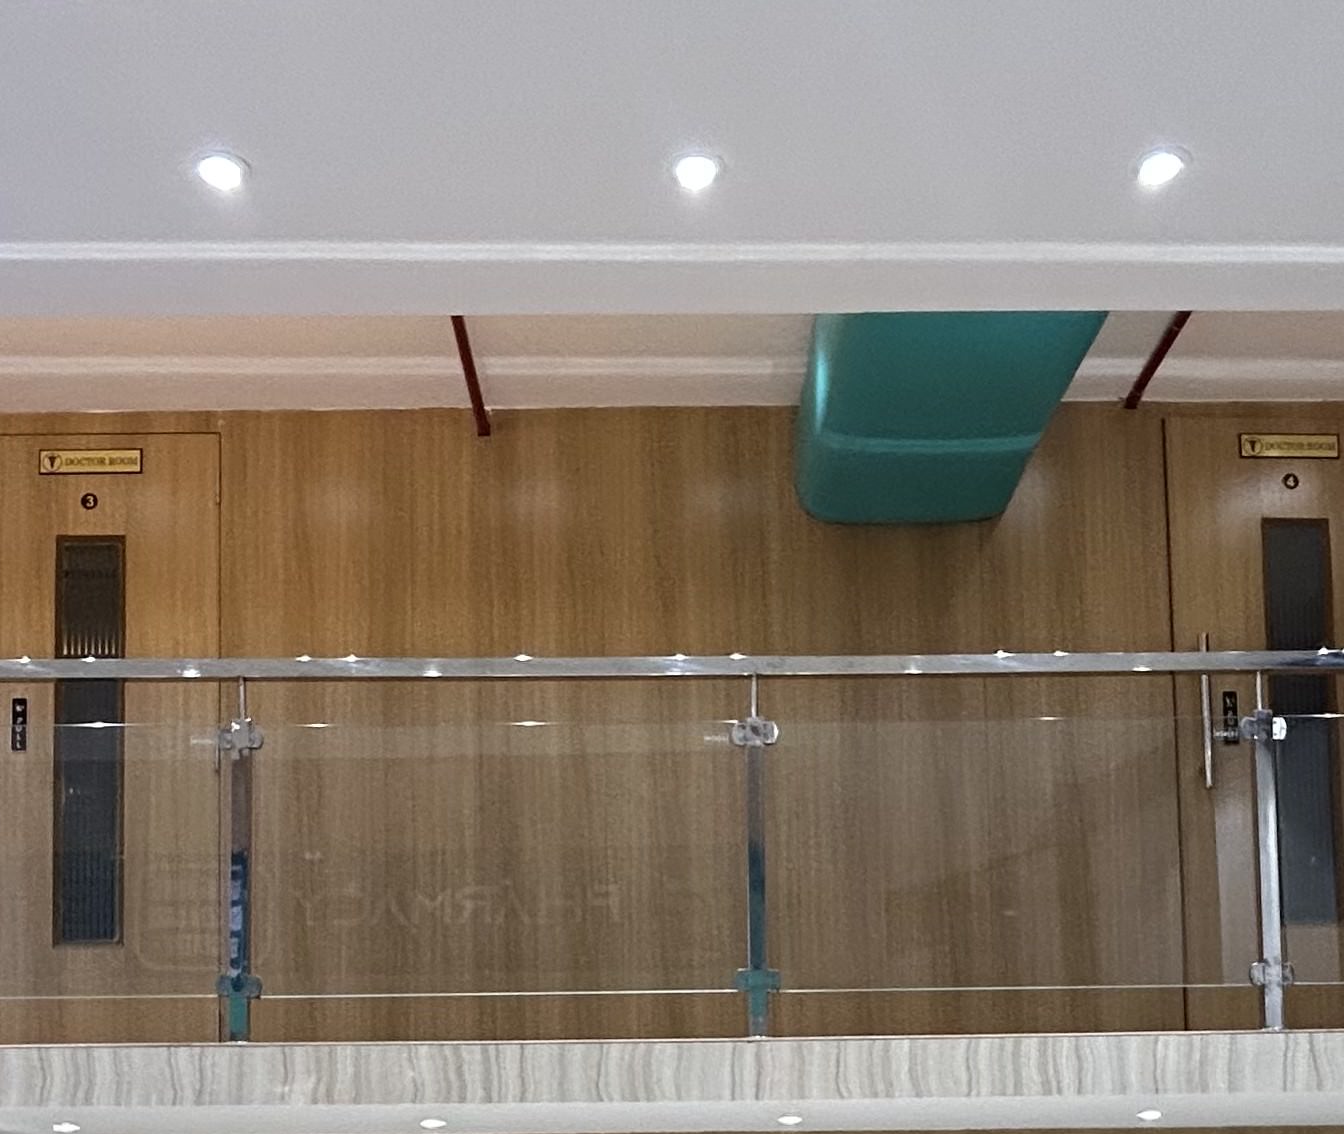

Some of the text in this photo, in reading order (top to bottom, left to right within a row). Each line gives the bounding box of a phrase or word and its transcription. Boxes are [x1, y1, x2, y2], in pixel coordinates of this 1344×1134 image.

[65, 456, 138, 466] DOCTOR ROOM
[86, 496, 94, 507] 3
